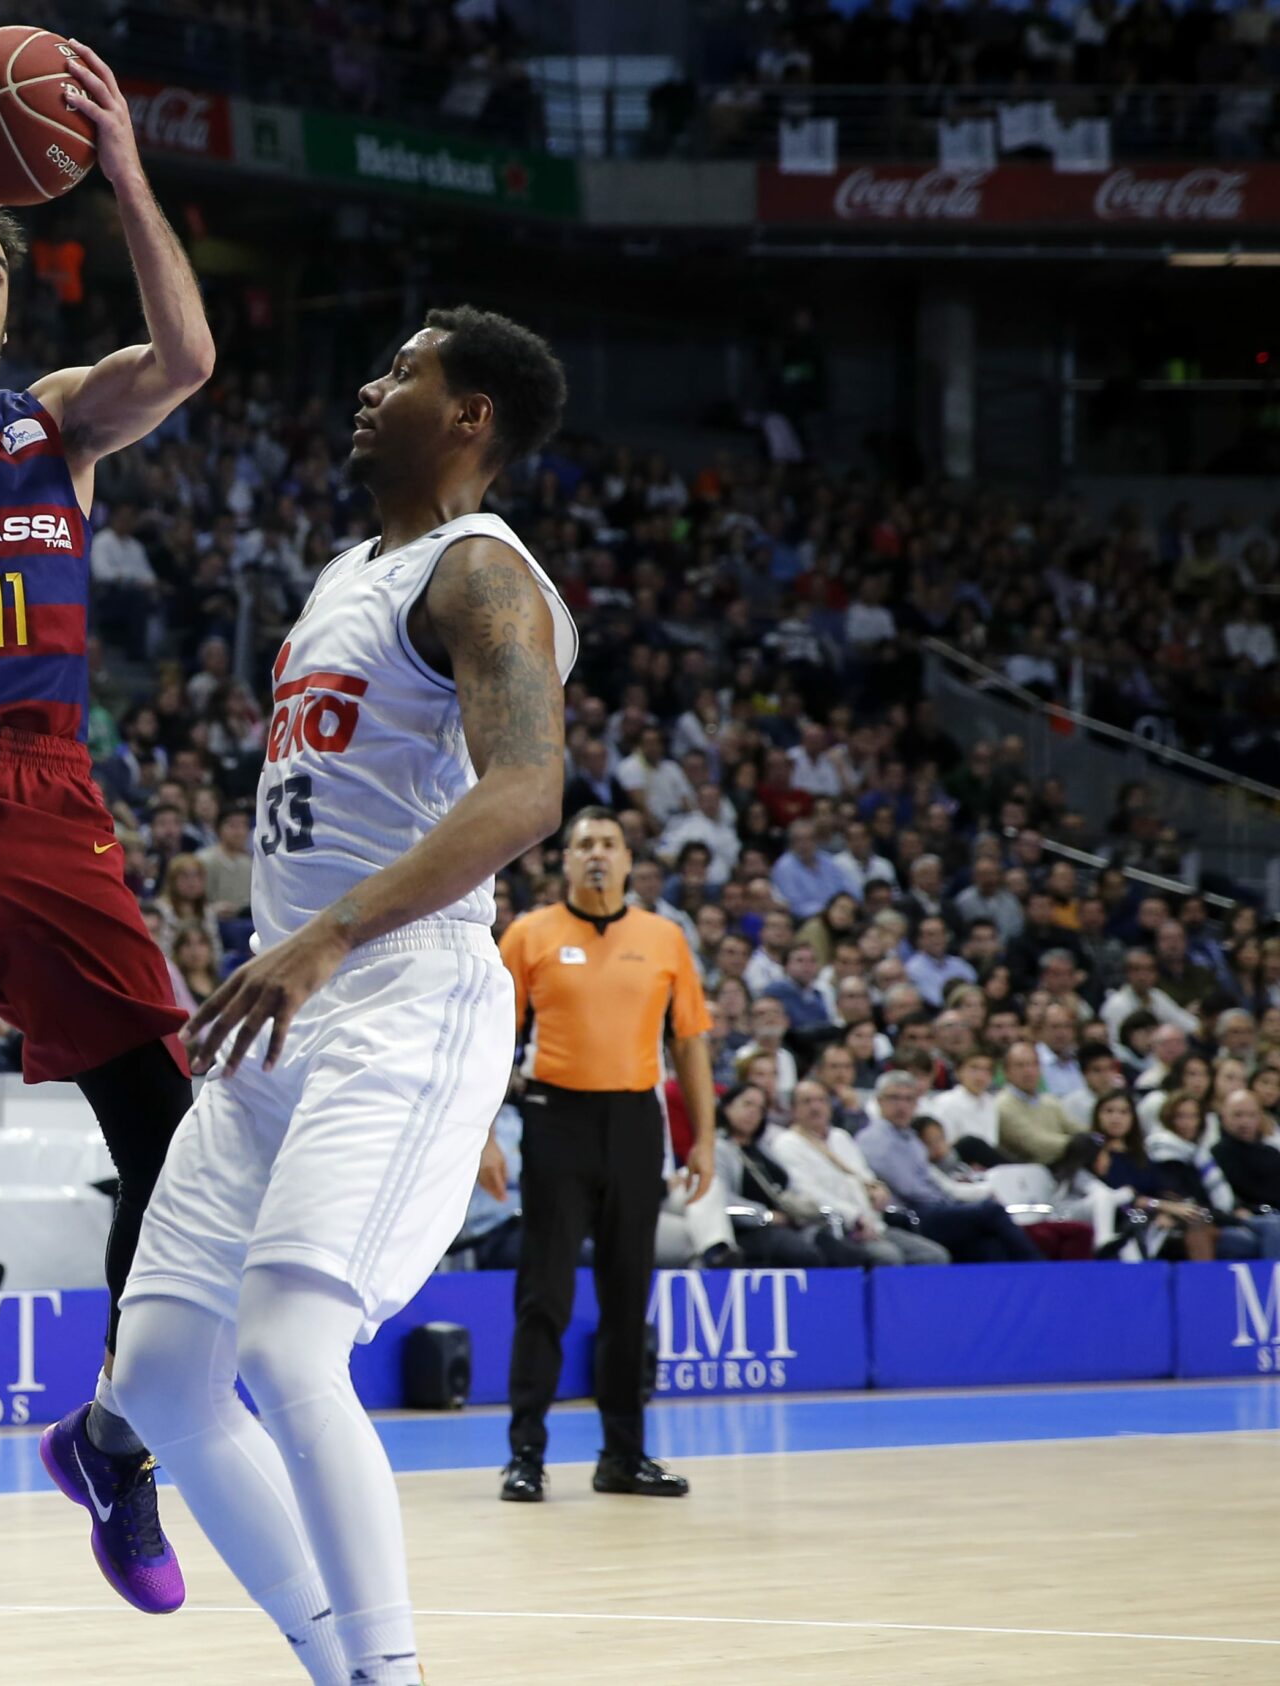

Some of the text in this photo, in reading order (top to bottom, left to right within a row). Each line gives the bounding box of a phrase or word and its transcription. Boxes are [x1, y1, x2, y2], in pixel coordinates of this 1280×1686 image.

[354, 132, 497, 196] Heineken
[44, 538, 73, 550] TYRE
[261, 774, 314, 856] 33
[655, 1360, 787, 1391] EGUROS
